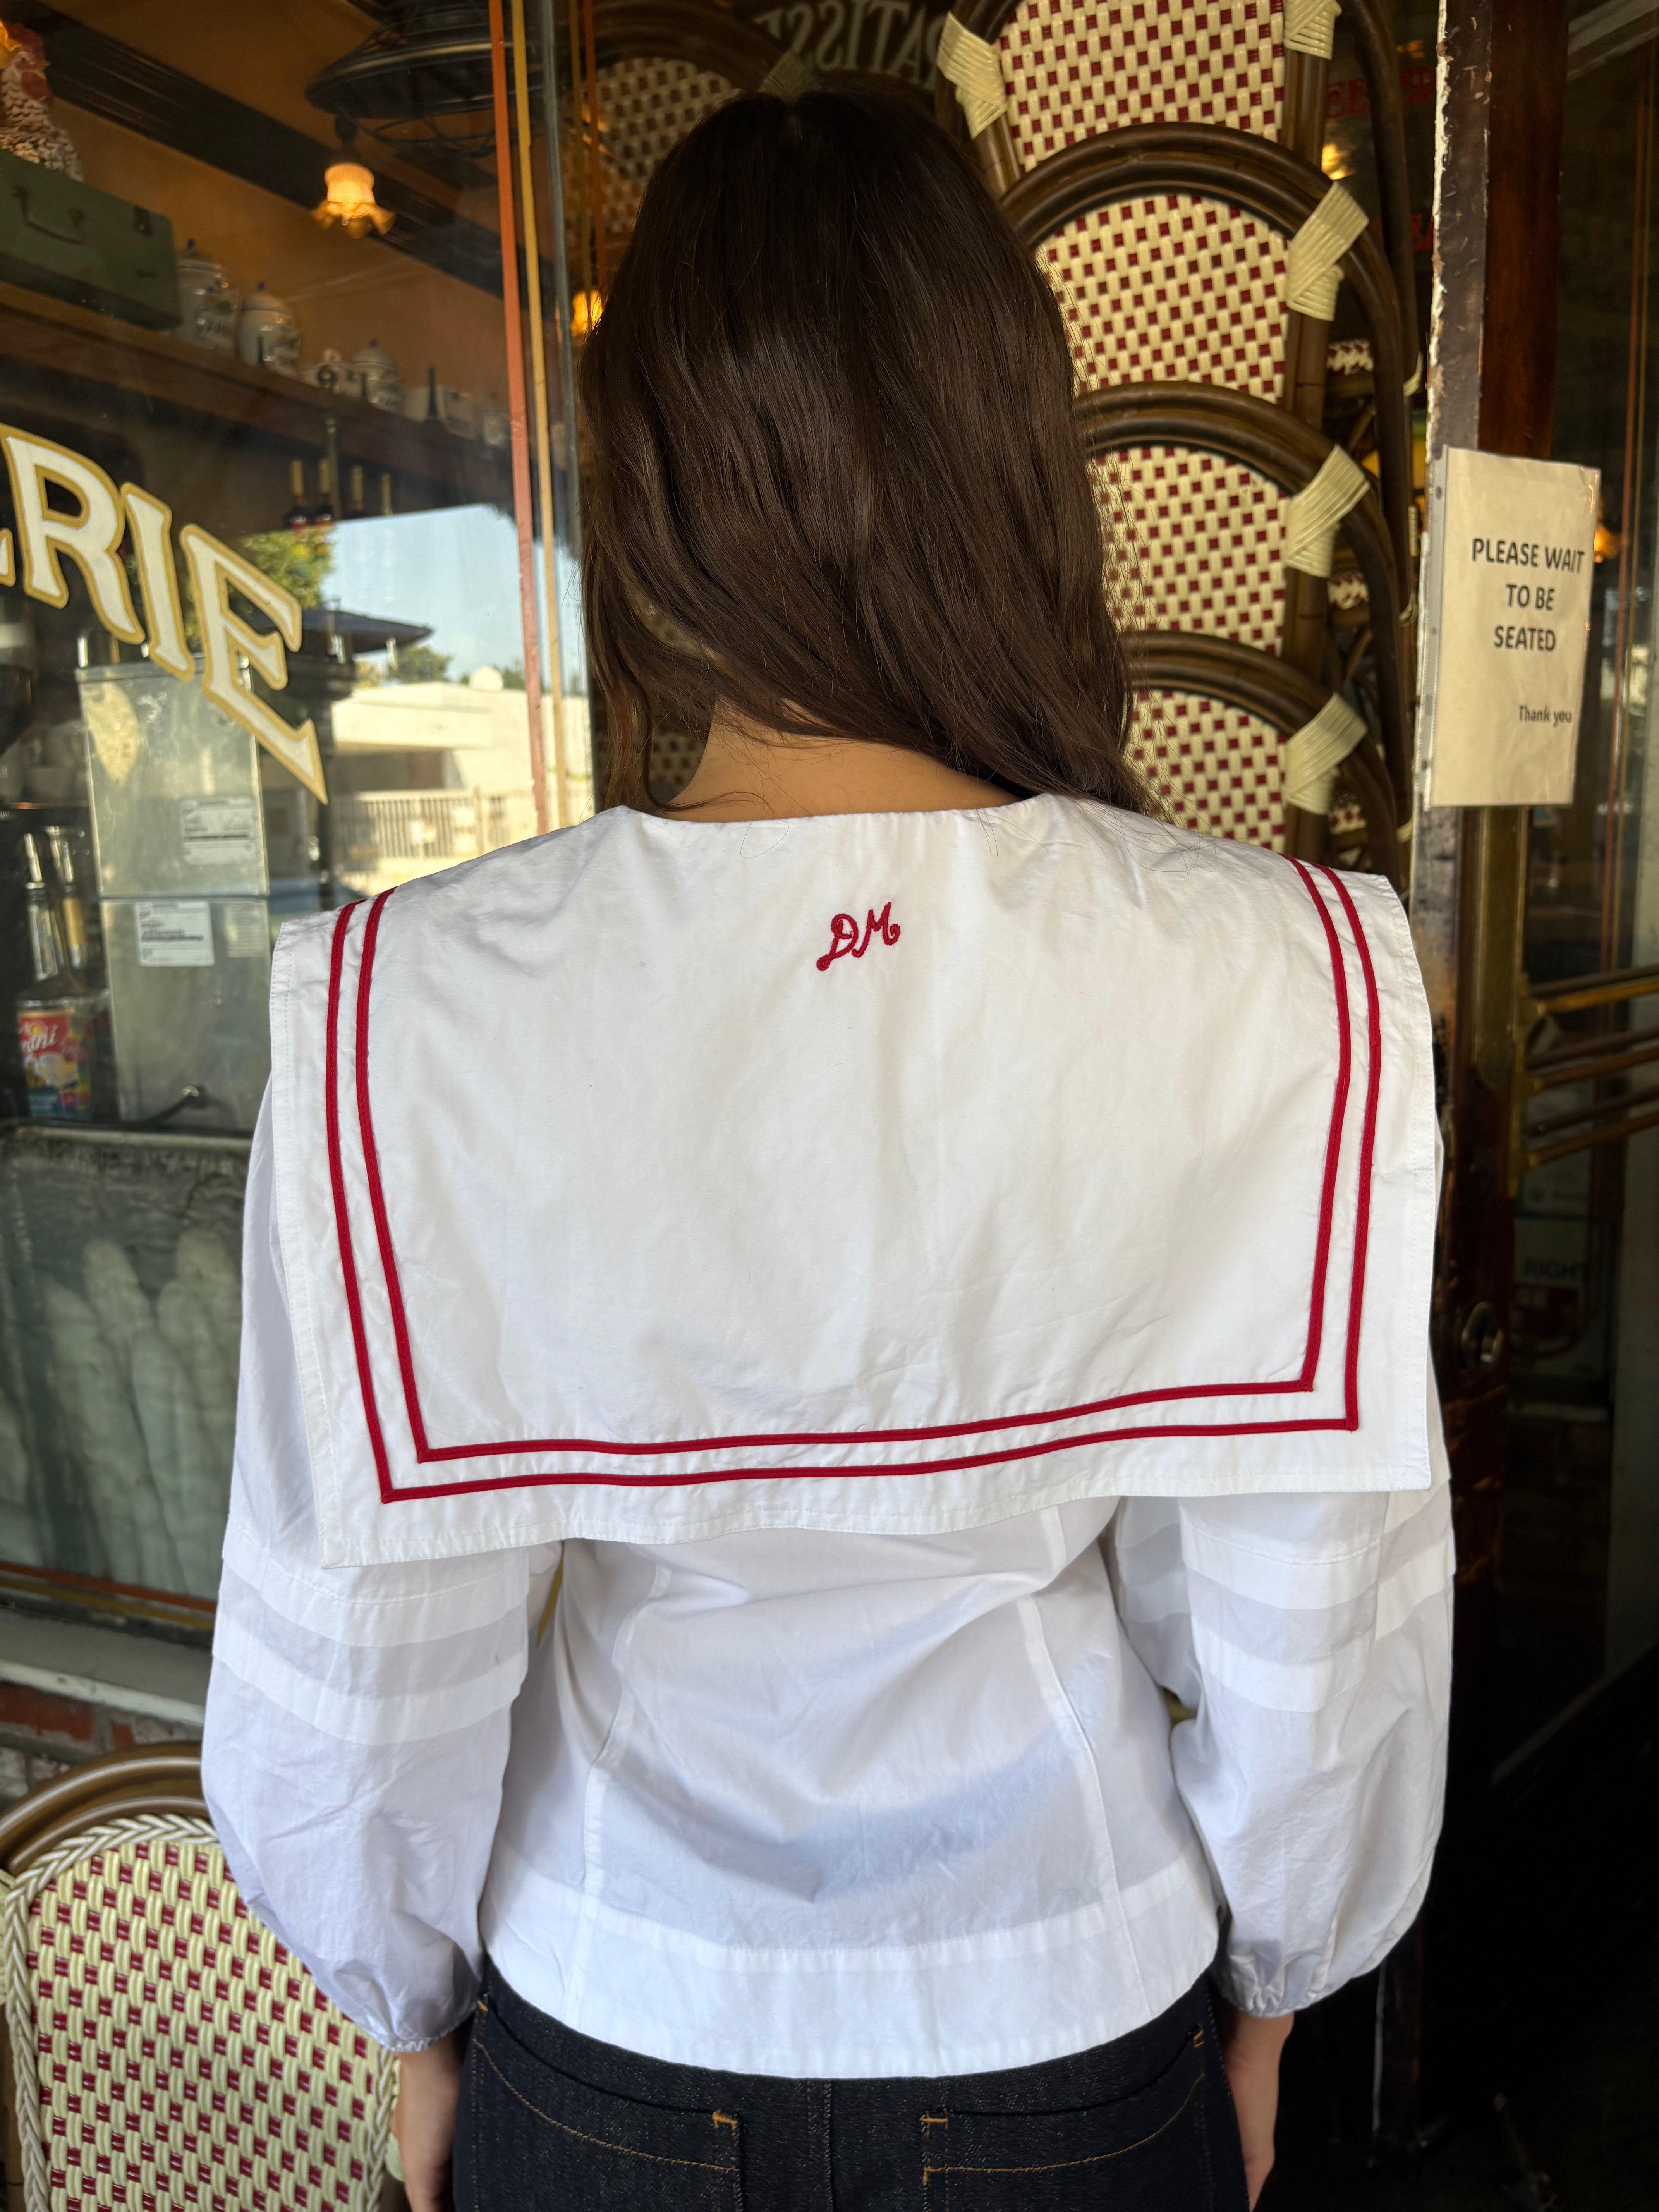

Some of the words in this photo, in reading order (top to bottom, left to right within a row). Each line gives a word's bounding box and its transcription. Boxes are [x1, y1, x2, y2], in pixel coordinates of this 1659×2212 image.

[1472, 538, 1540, 567] PLEASE
[1544, 546, 1585, 573] WAIT
[1506, 584, 1530, 608] TO
[1535, 587, 1554, 611] BE
[0, 424, 328, 804] RIE
[1494, 625, 1556, 652] SEATED
[1518, 705, 1549, 722] Thank
[1553, 710, 1571, 726] you
